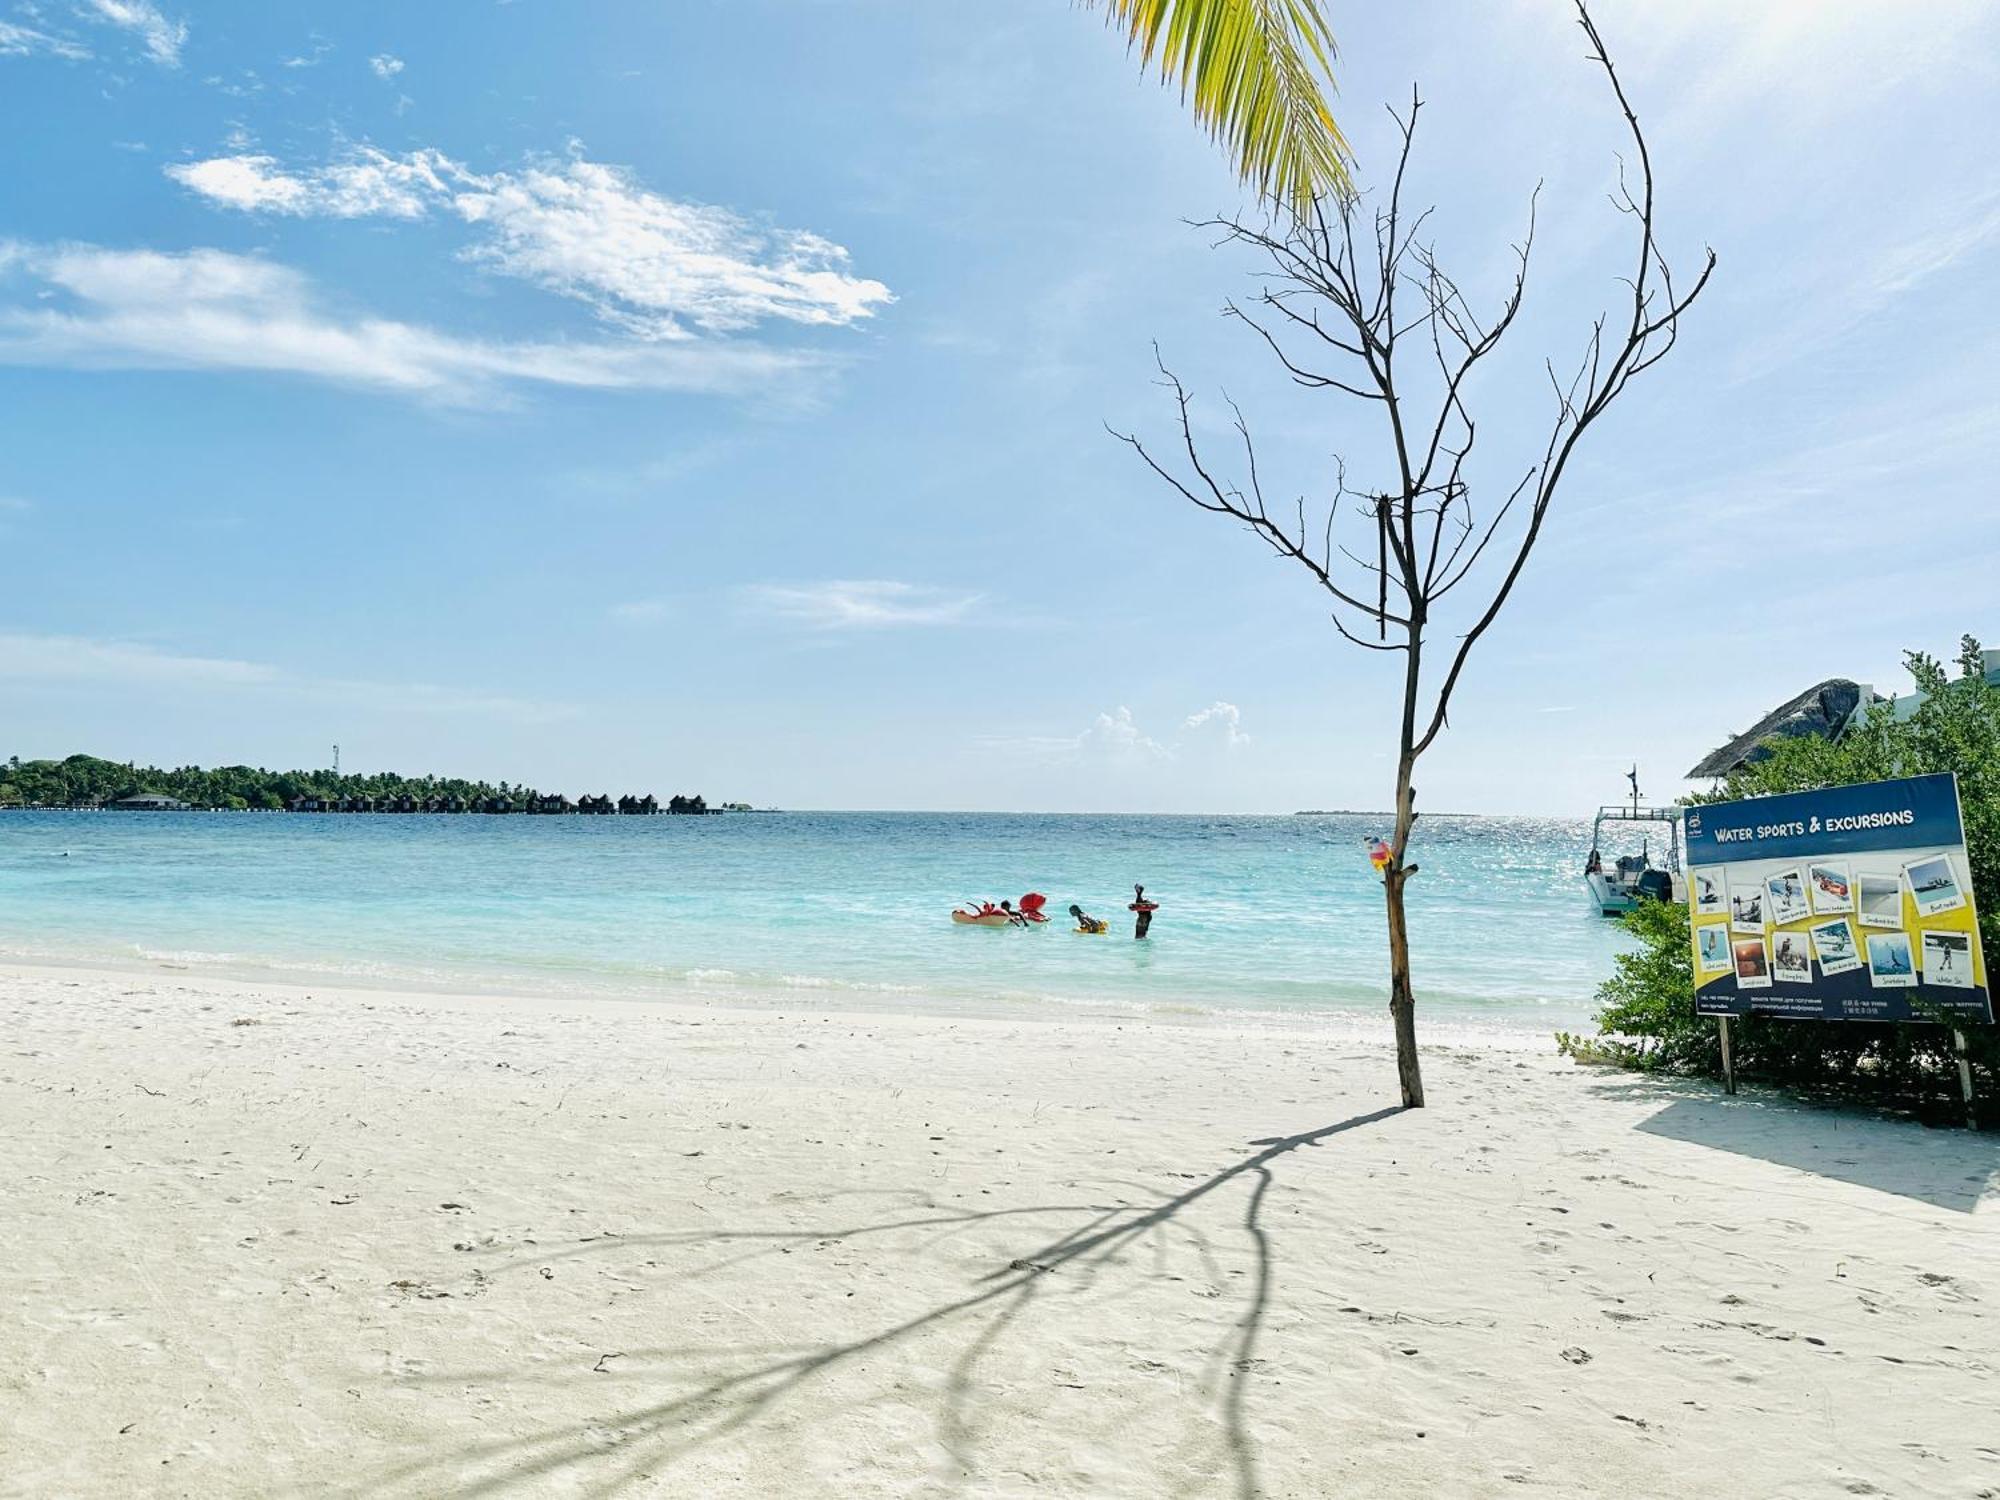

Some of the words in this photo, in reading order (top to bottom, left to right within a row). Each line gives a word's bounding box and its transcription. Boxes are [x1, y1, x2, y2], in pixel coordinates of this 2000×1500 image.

[1714, 827, 1753, 843] WATER
[1756, 822, 1805, 839] SPORTS
[1809, 816, 1821, 833] &
[1825, 809, 1914, 832] EXCURSIONS
